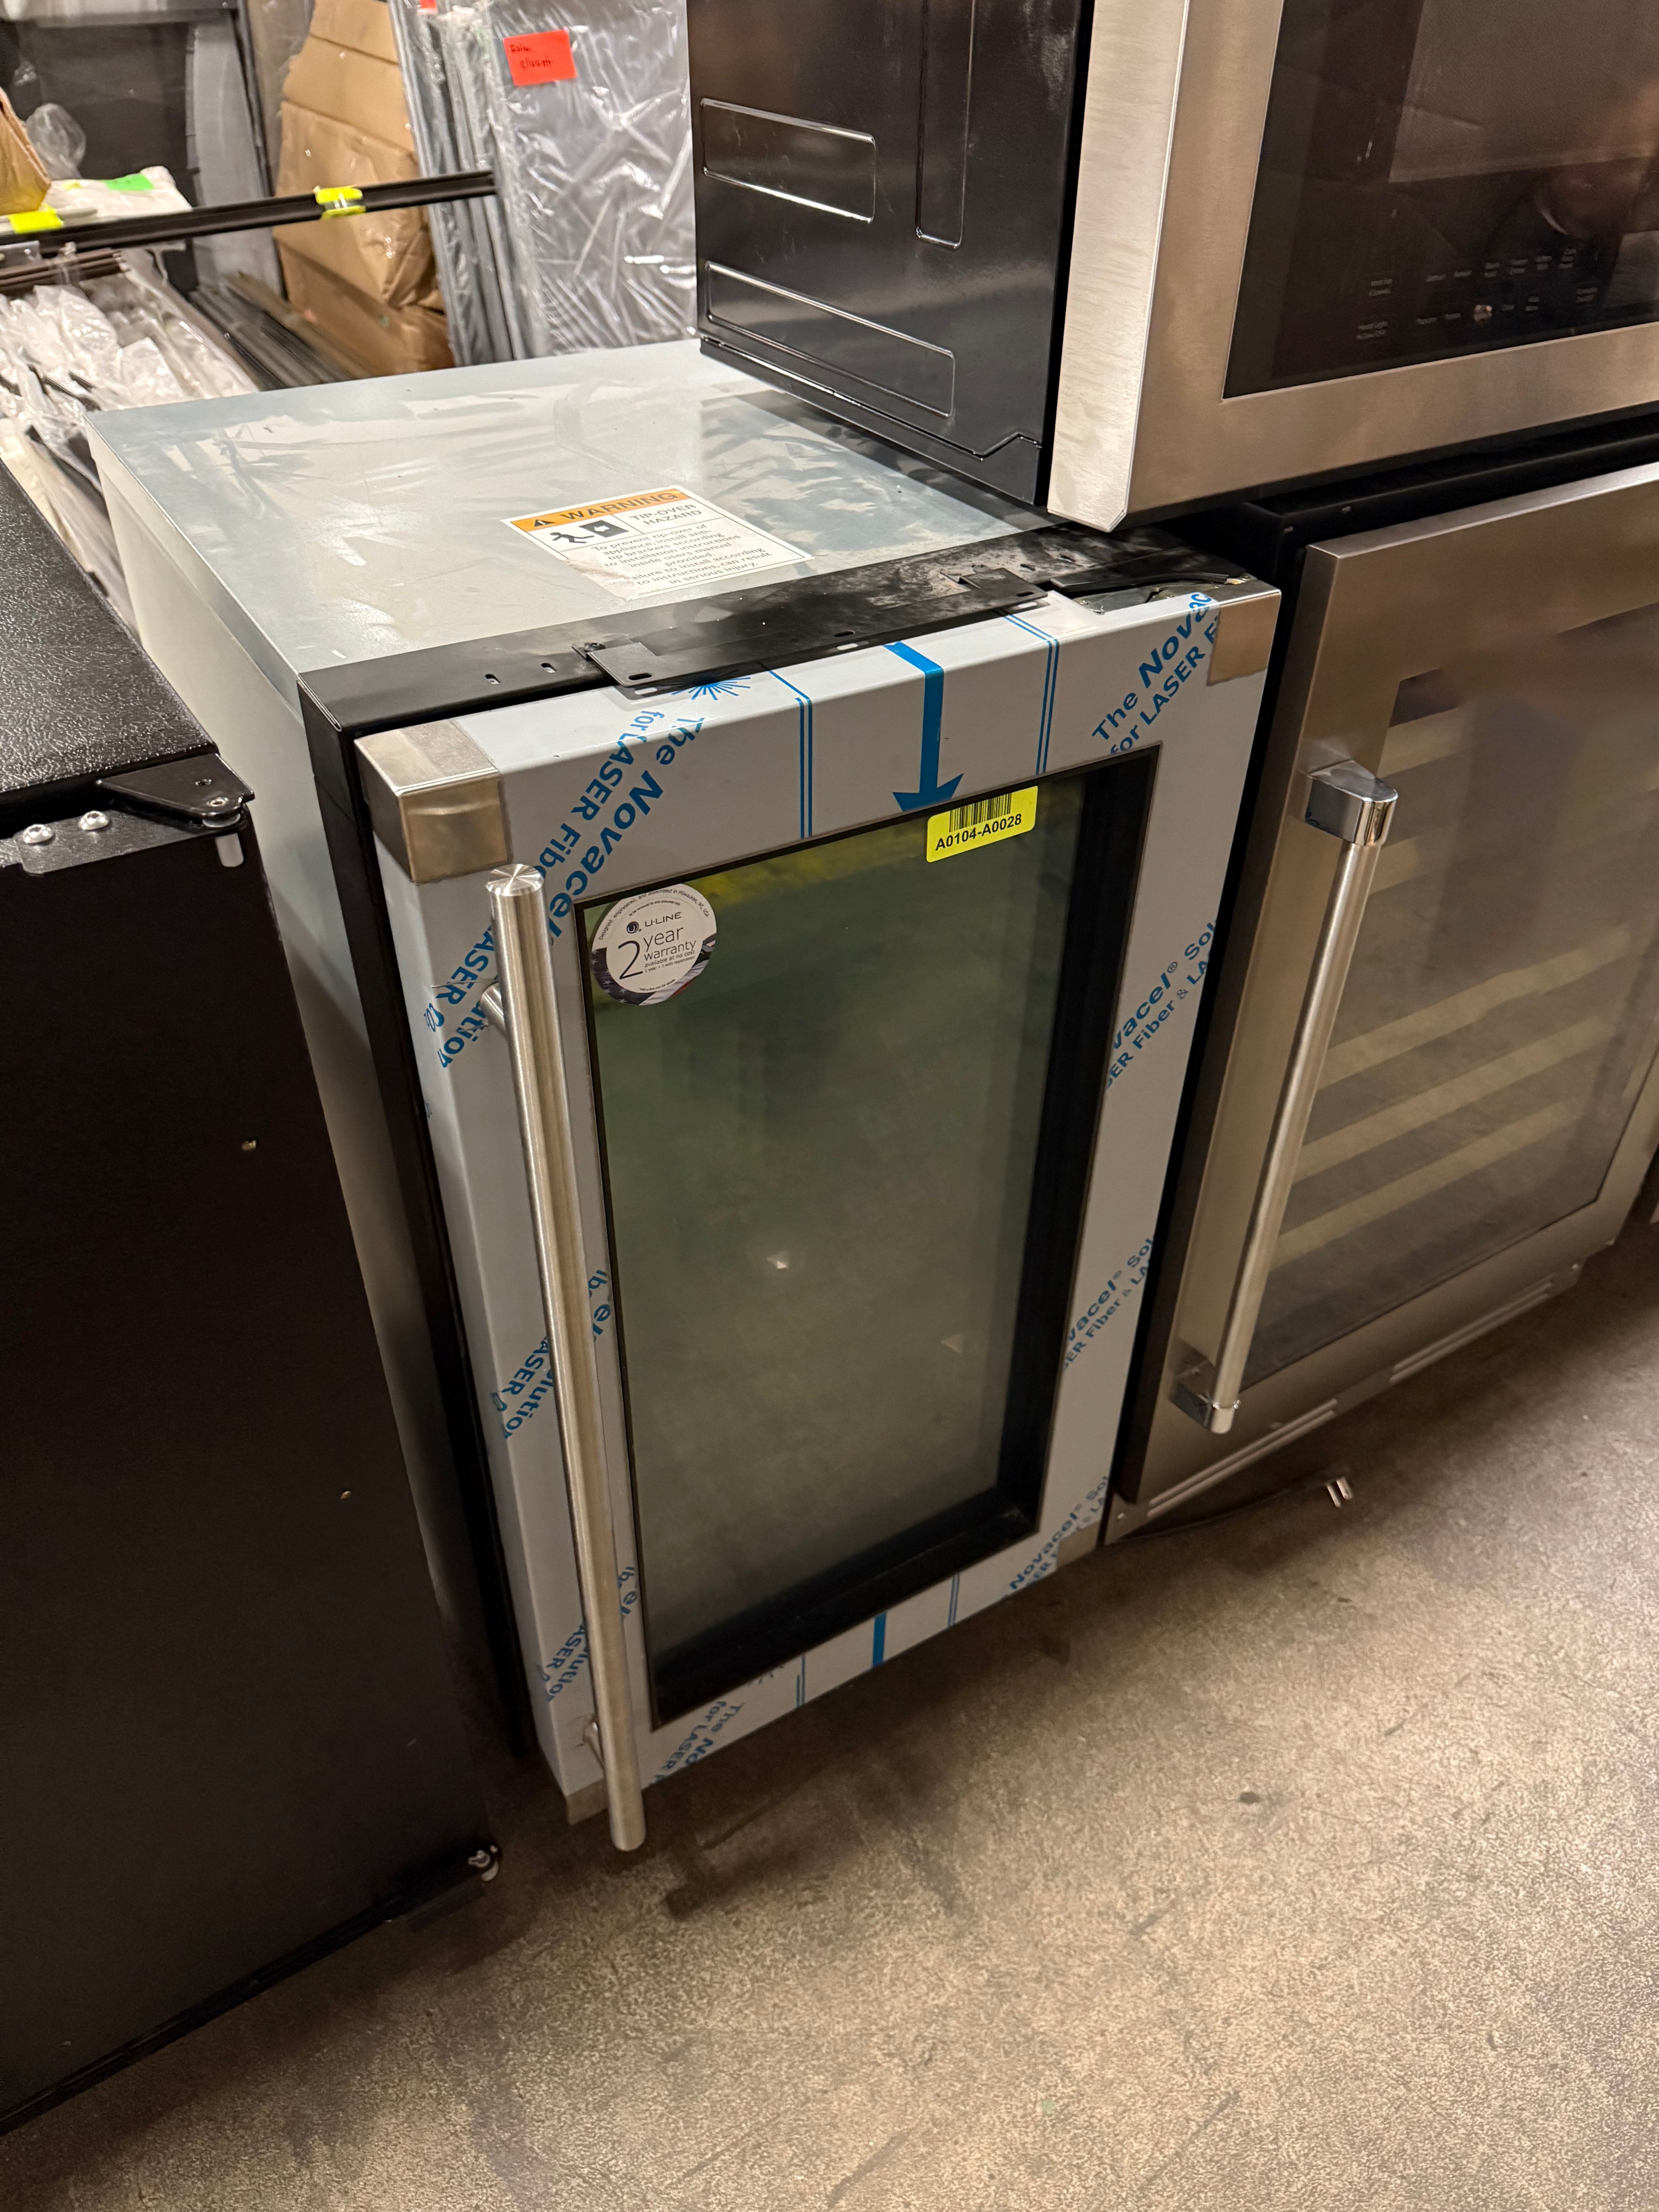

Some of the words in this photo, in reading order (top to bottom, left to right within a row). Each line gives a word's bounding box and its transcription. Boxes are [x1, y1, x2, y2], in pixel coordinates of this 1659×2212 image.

[560, 493, 679, 520] WARNING
[629, 504, 696, 521] TIP-OVER
[643, 510, 702, 526] HAZARD
[603, 542, 656, 555] appliance,
[655, 534, 687, 544] install
[610, 536, 651, 548] prevent
[652, 528, 692, 539] tip-over
[619, 548, 678, 564] installation
[678, 535, 741, 551] instructions
[624, 544, 671, 557] brackets
[672, 533, 725, 546] according
[629, 558, 662, 568] inside
[664, 551, 693, 560] users
[694, 542, 732, 553] manual
[630, 571, 663, 580] ailure
[678, 559, 711, 569] install
[713, 548, 766, 562] according
[665, 552, 716, 567] provided.
[741, 552, 772, 562] result
[683, 570, 723, 581] serious
[723, 562, 758, 572] injury.
[1092, 692, 1138, 740] The
[1138, 594, 1212, 688] Novac
[1110, 725, 1140, 755] for
[1139, 646, 1206, 725] LASER
[630, 710, 665, 731] for
[656, 717, 705, 765] The
[570, 733, 647, 821] LASER
[936, 814, 1022, 850] A0104-A0028
[533, 823, 581, 879] Fib
[435, 926, 495, 1005] ASER
[618, 940, 643, 979] 2
[643, 927, 684, 952] year
[644, 940, 696, 961] warranty
[644, 958, 668, 967] available
[1133, 999, 1175, 1049] Fiber
[1067, 1270, 1122, 1341] vacel
[1086, 1298, 1121, 1338] Fiber
[501, 1336, 549, 1395] ASER
[546, 1624, 586, 1669] ASER
